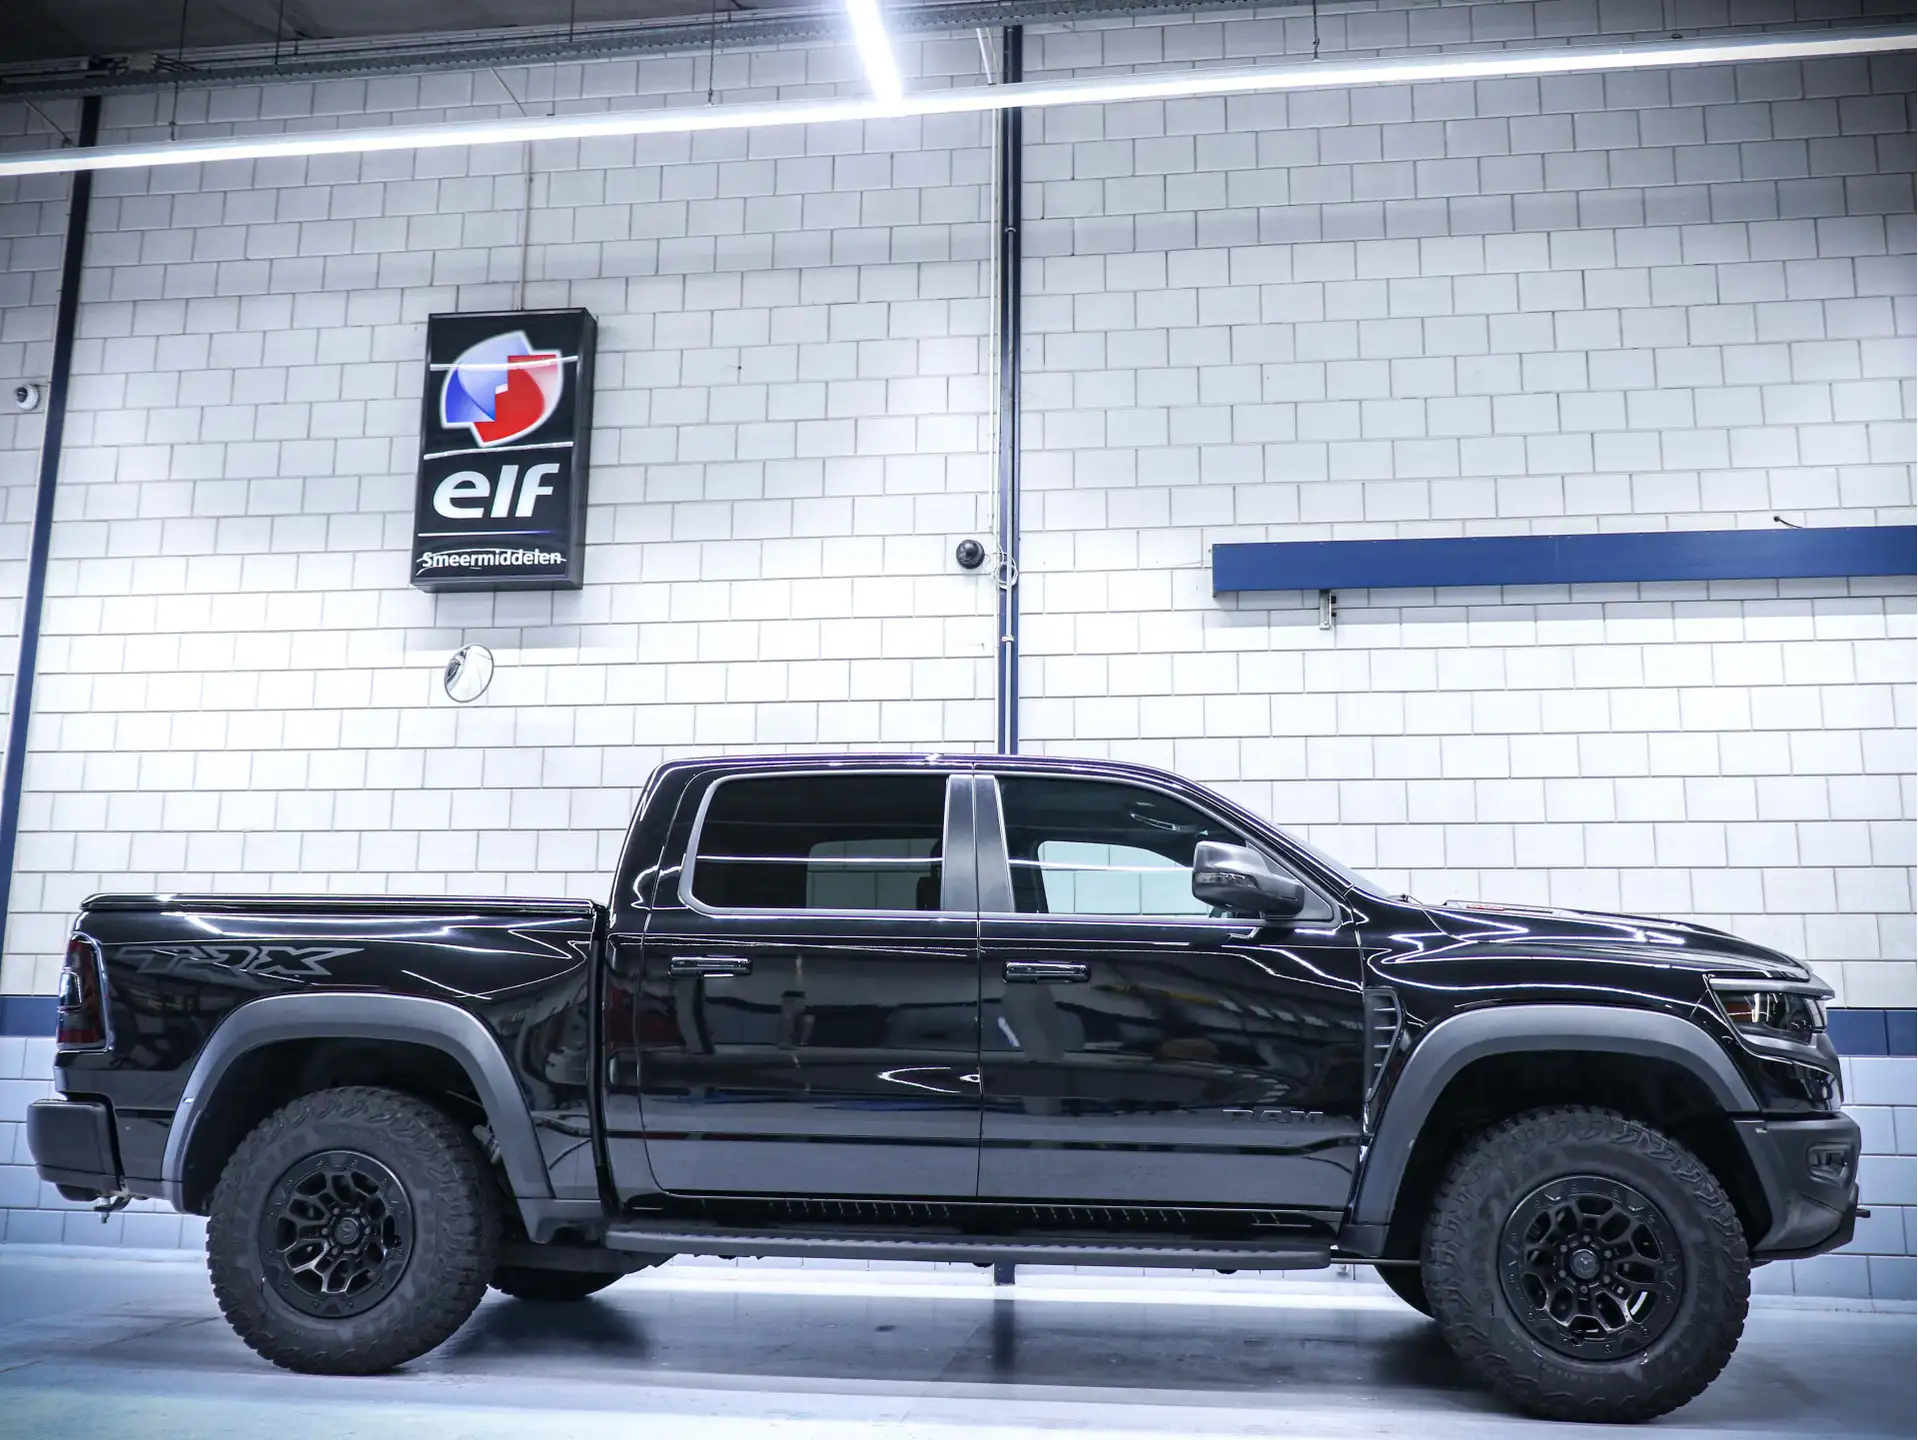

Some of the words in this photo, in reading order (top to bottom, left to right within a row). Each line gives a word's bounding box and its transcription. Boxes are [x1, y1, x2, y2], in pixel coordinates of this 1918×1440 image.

[433, 463, 560, 518] elf
[421, 549, 562, 567] Smeermiddelen
[1222, 1109, 1324, 1124] RAM
